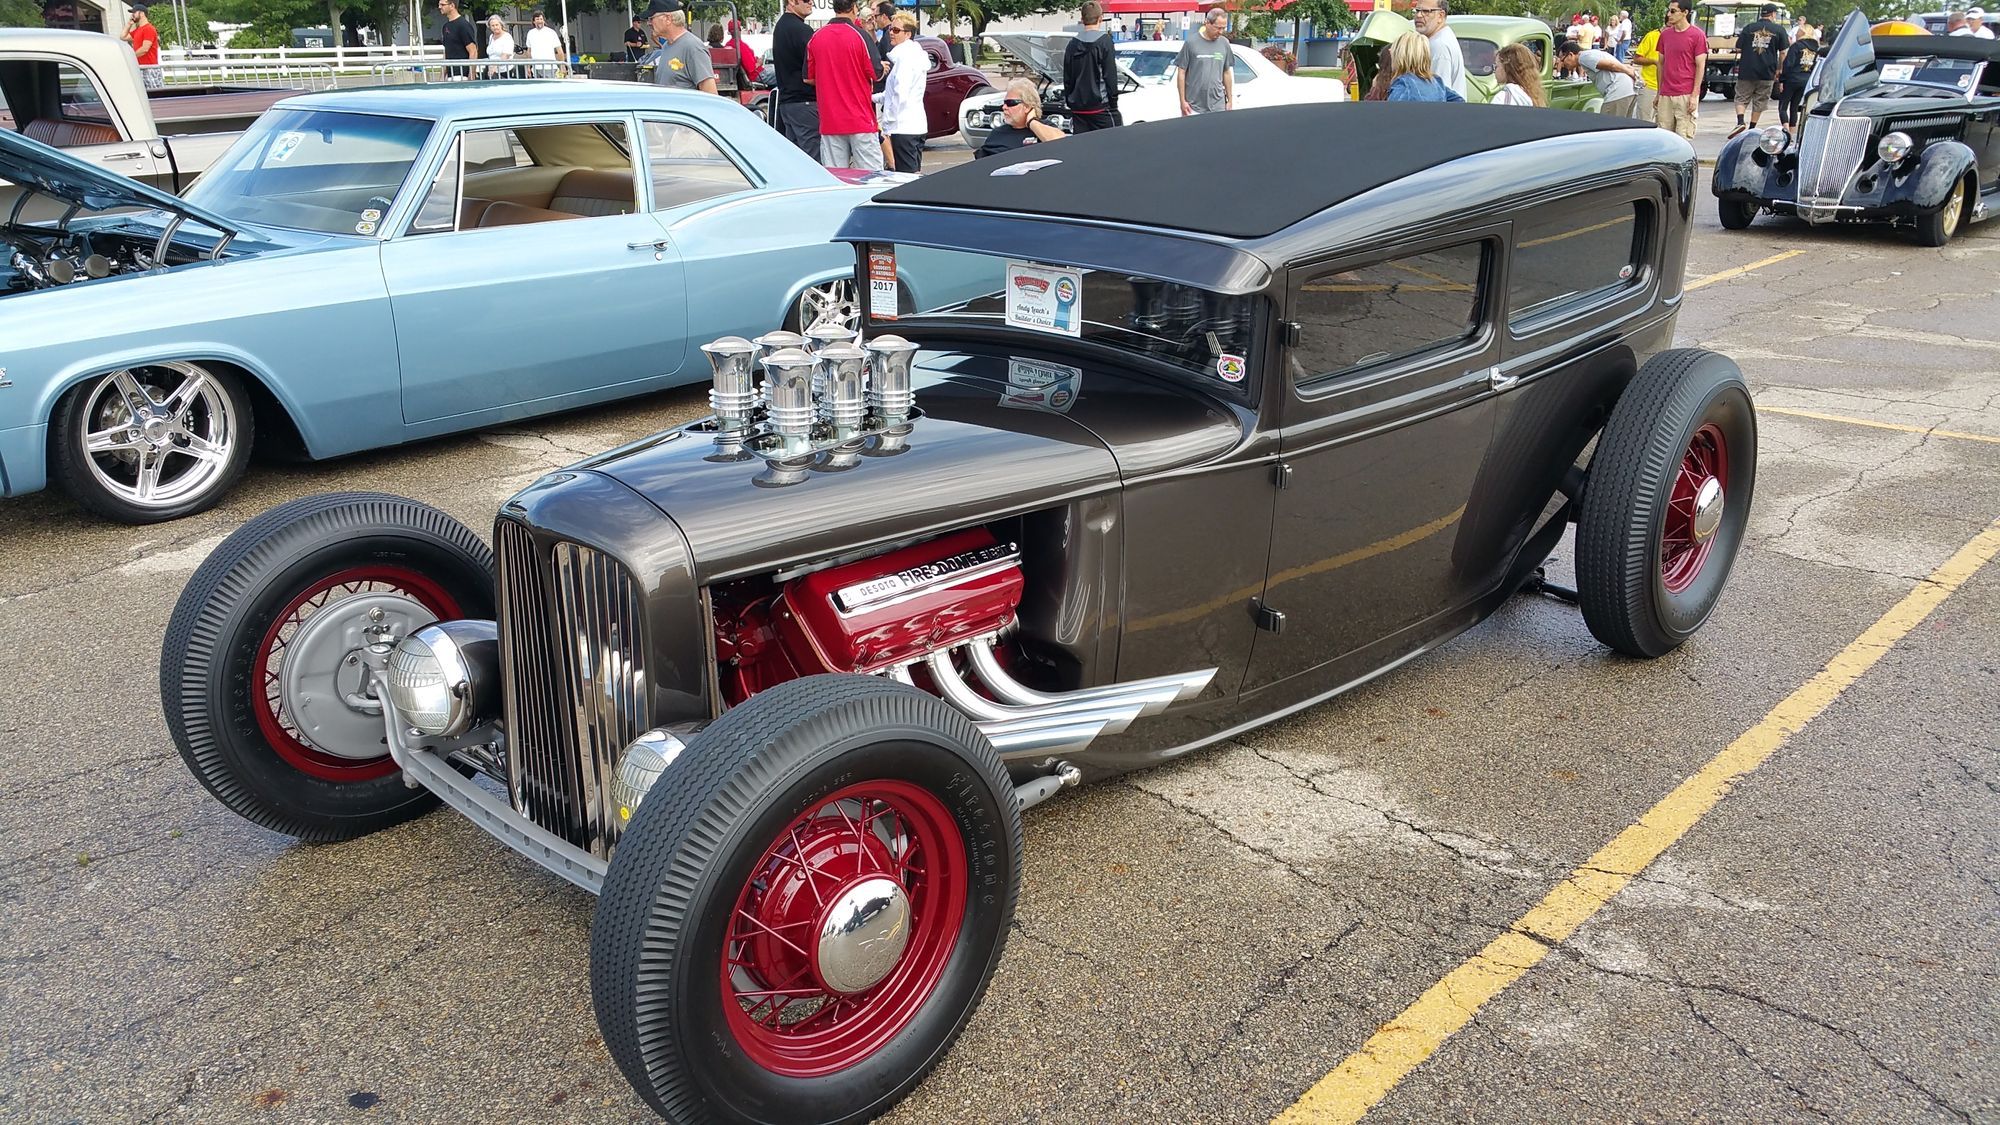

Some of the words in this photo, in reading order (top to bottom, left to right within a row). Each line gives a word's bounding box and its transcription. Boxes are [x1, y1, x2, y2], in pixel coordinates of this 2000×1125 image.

[873, 281, 894, 291] 2017
[1017, 303, 1030, 312] Andy
[1036, 317, 1052, 326] Choice
[859, 579, 897, 596] DESOTO
